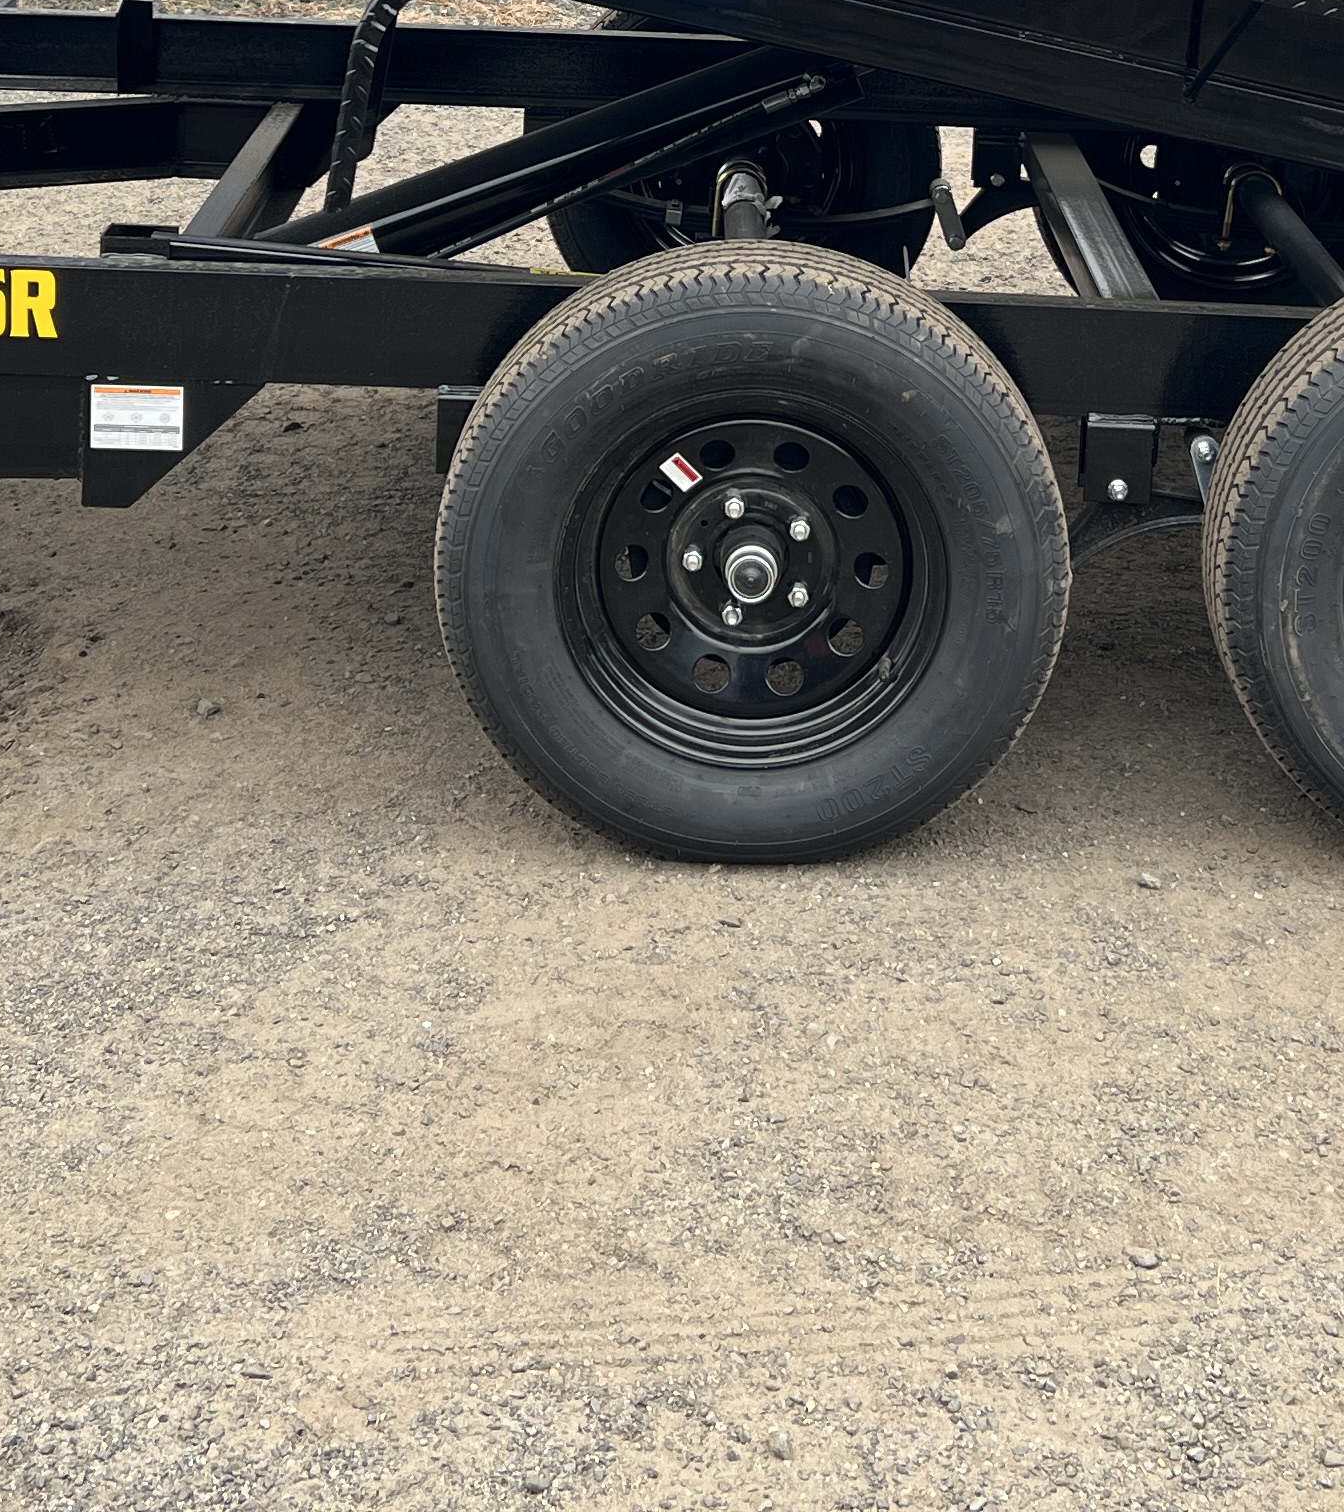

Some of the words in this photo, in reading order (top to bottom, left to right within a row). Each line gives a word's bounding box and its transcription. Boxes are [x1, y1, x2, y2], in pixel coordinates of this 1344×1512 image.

[541, 341, 775, 464] GOODRIDE
[1294, 512, 1332, 638] ST200
[816, 745, 933, 822] ST200
